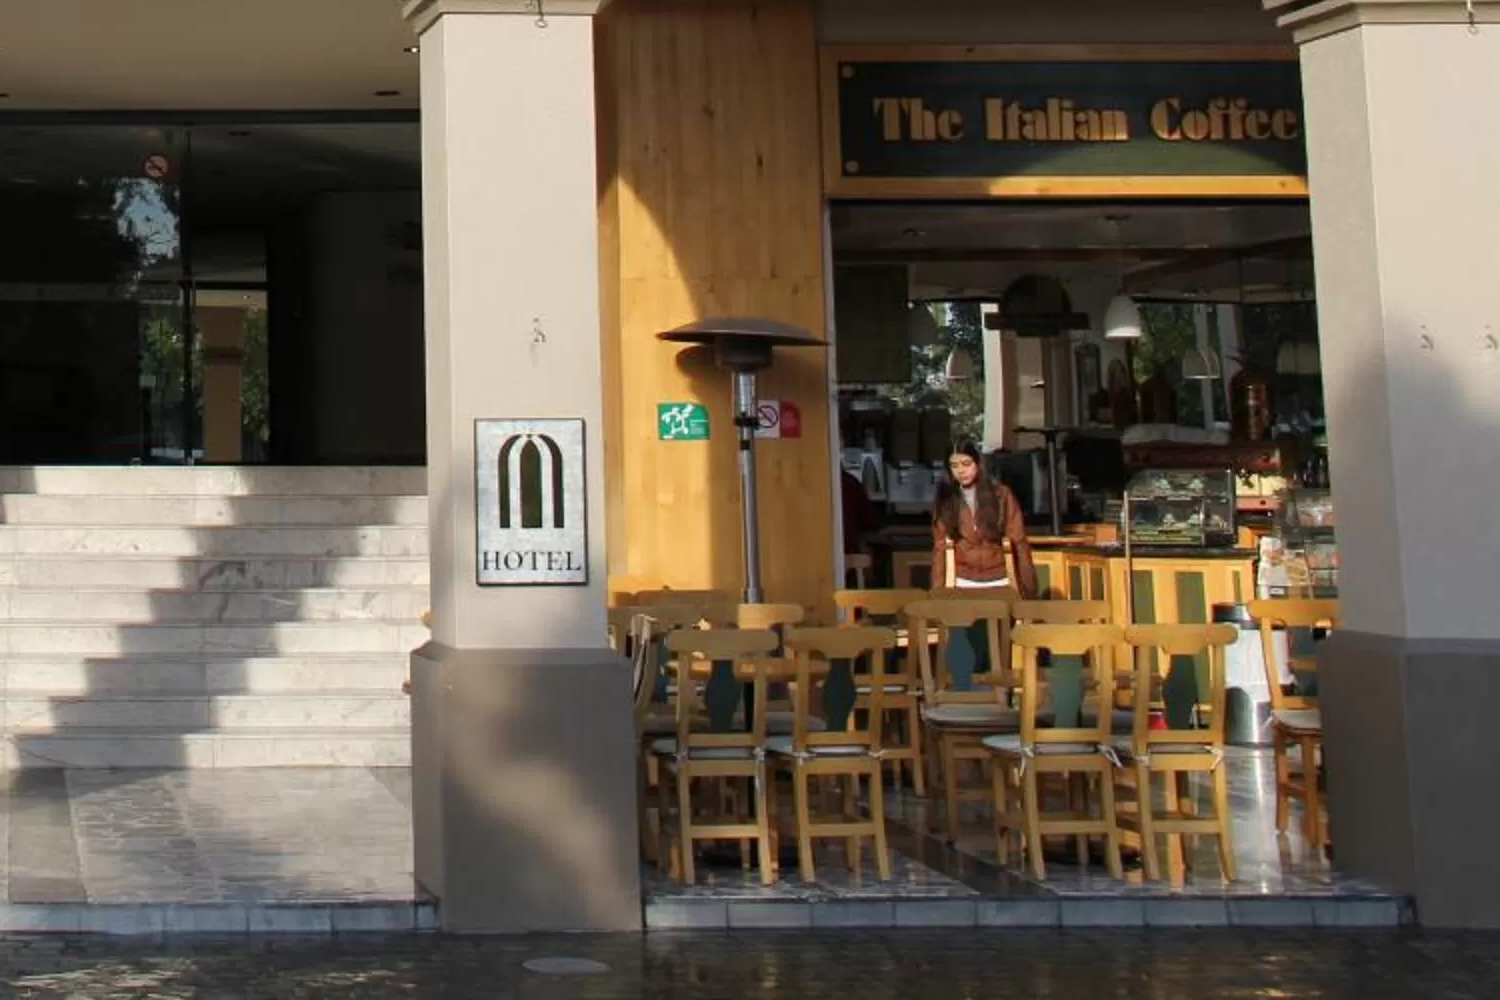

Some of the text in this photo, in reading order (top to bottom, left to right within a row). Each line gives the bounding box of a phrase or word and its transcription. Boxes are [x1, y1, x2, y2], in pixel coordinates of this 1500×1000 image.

[873, 96, 1299, 141] The Italian Coffee
[482, 550, 582, 571] HOTEL
